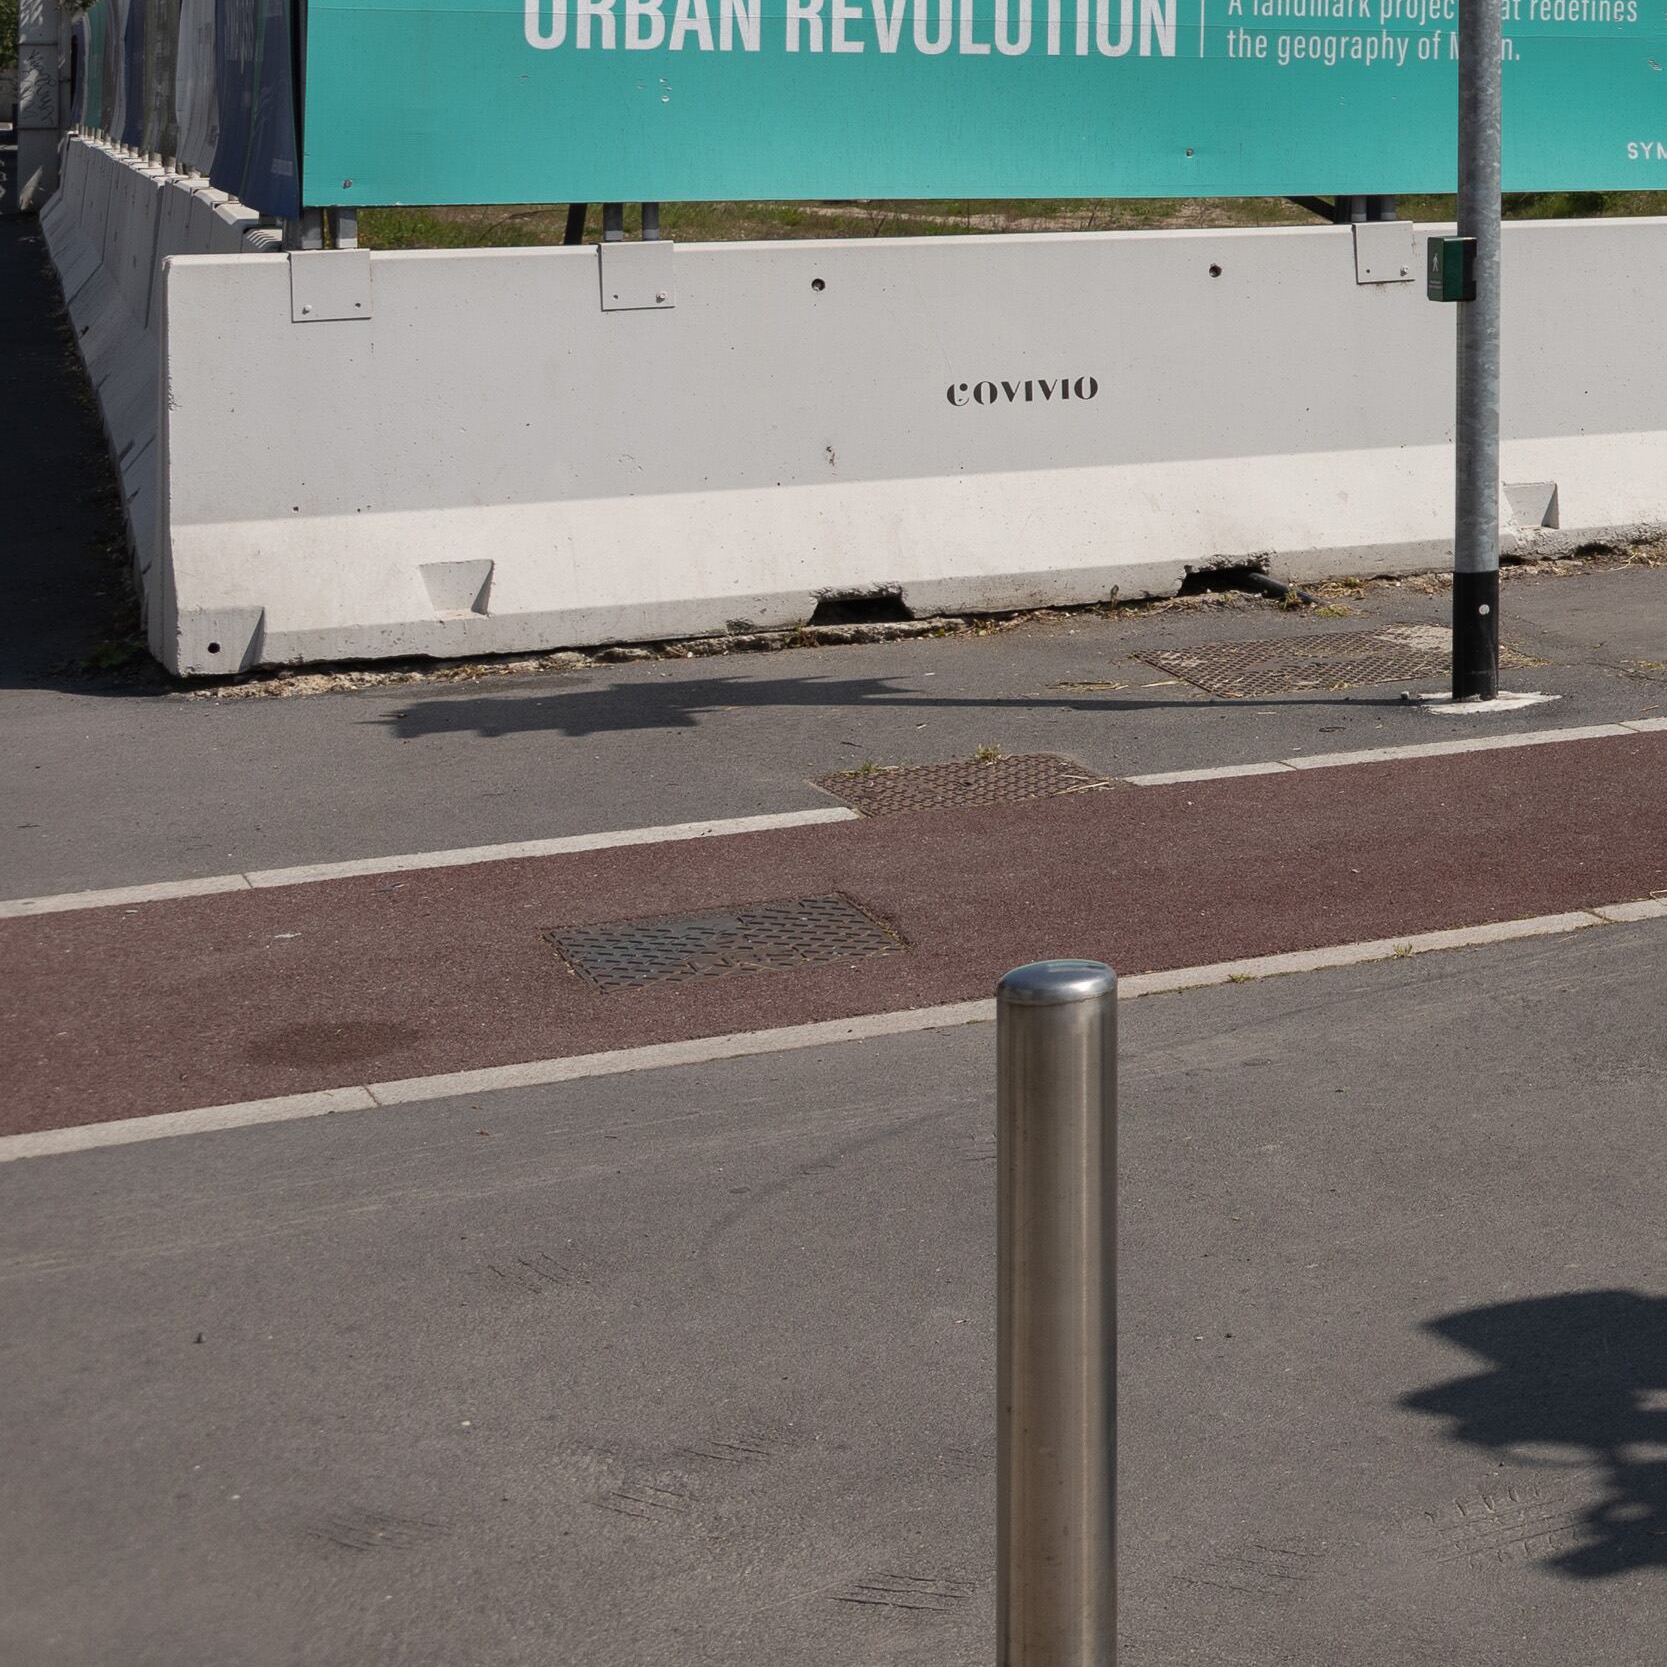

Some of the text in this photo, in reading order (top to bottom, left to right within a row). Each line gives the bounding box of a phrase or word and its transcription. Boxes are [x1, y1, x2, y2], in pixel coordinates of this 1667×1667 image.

[1227, 26, 1268, 59] the
[1278, 29, 1409, 67] geography
[1417, 30, 1442, 60] of
